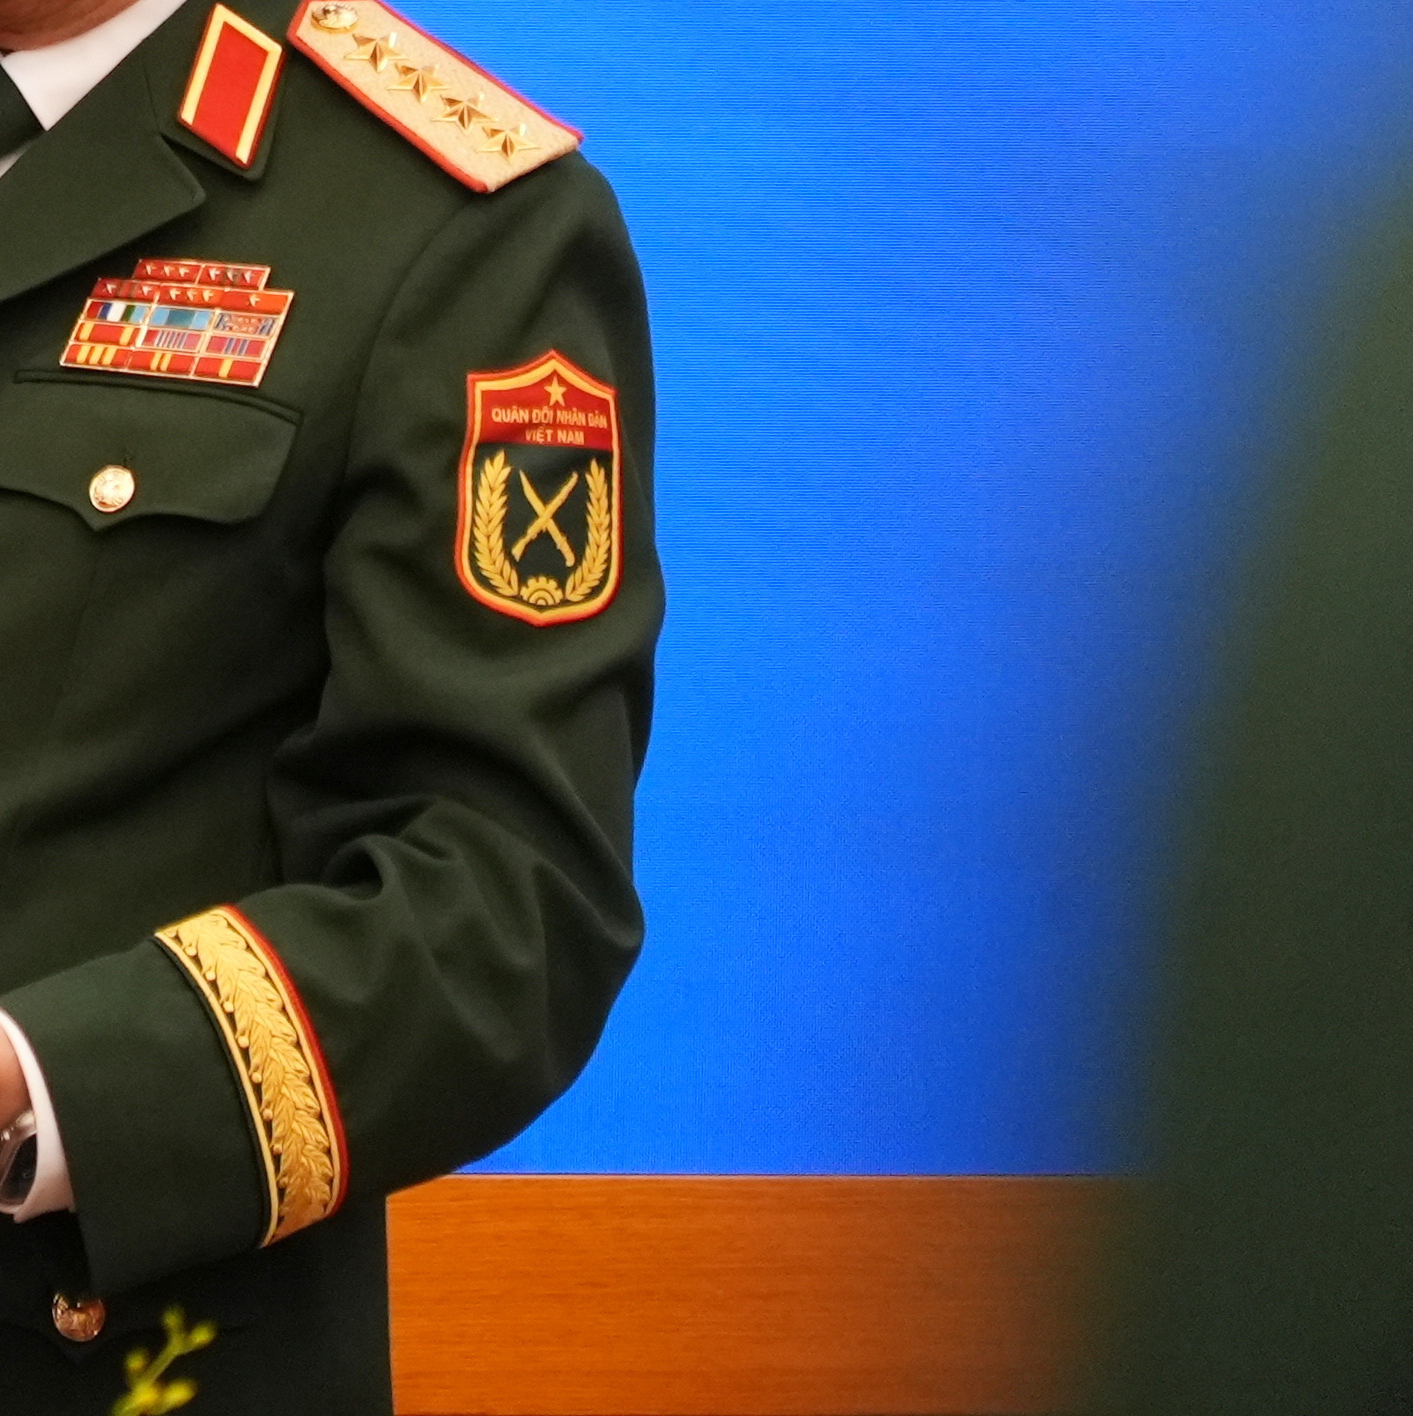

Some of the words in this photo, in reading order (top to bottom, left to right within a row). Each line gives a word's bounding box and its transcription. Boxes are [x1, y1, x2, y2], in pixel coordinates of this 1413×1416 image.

[491, 405, 529, 424] QUÂN
[556, 407, 587, 427] NHÂN
[525, 424, 554, 445] VIỆT
[557, 429, 585, 445] NAM
